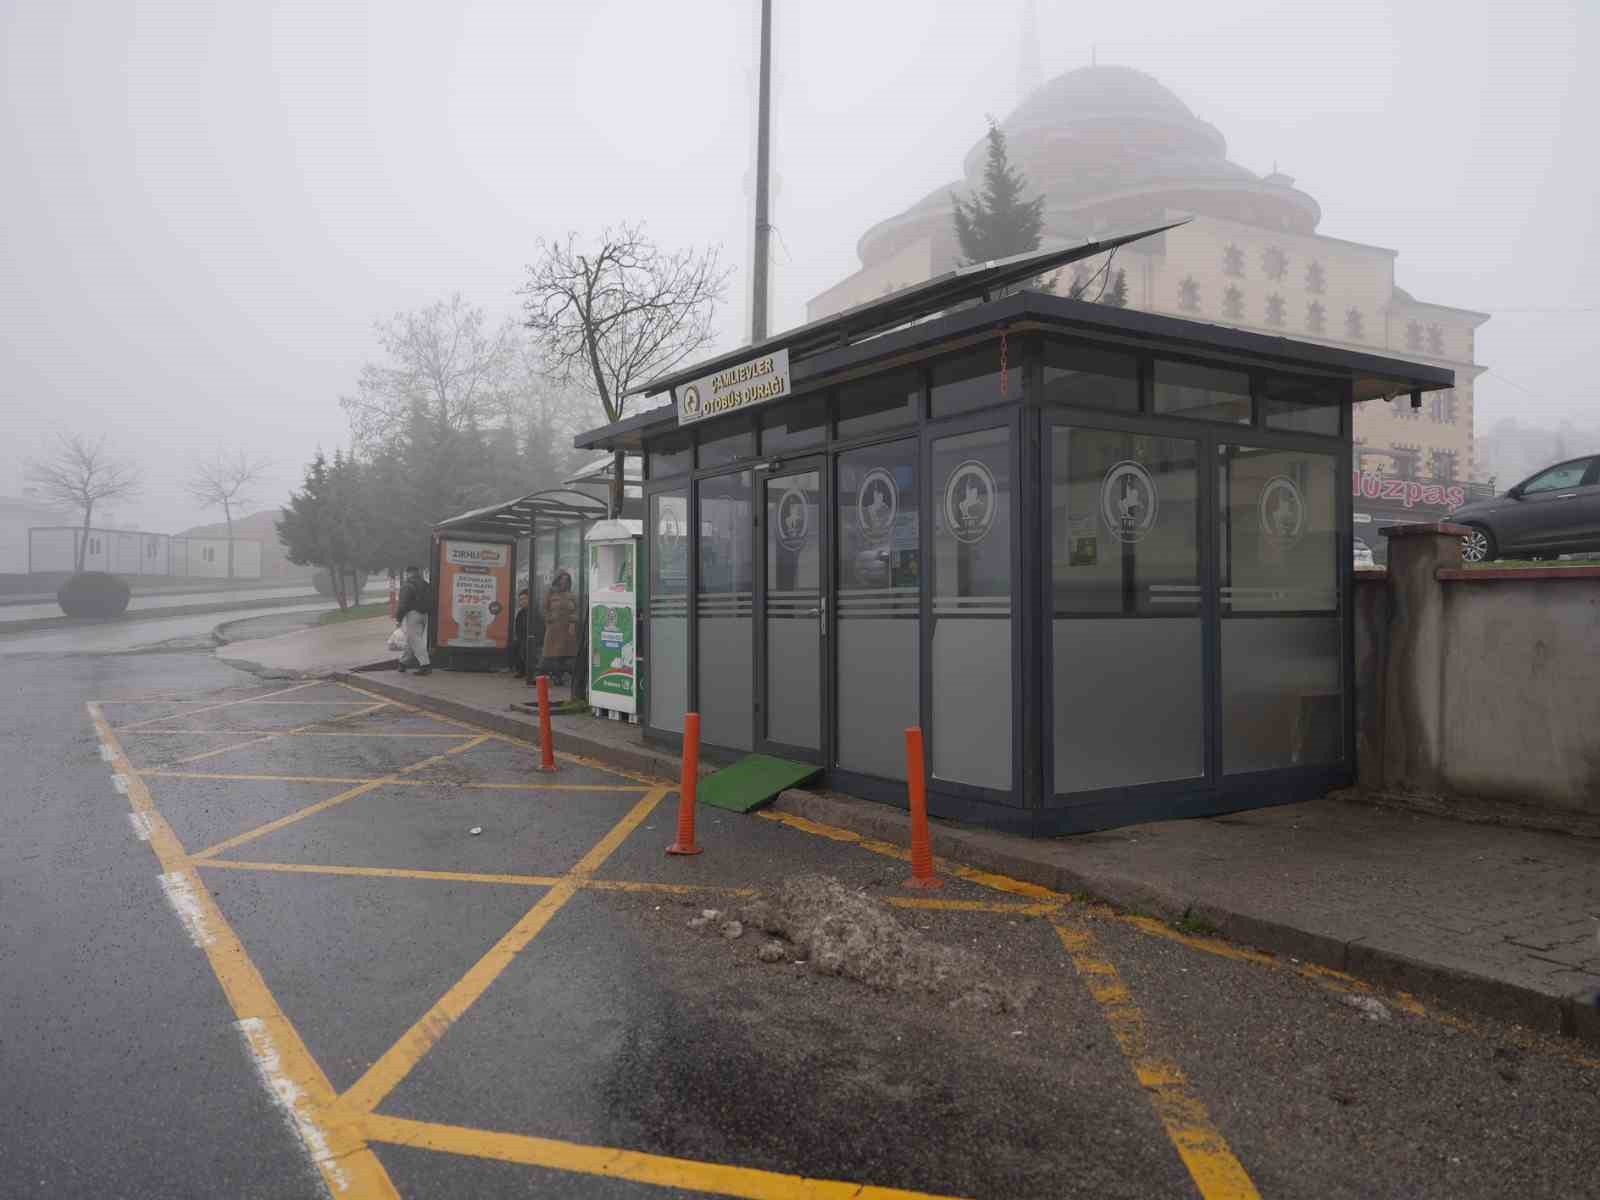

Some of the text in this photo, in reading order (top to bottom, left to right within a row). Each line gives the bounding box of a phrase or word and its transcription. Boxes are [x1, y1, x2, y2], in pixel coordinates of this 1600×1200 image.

[712, 358, 774, 393] ÇAMLIEVLER
[703, 376, 785, 416] OTOBÜS DURAĞI
